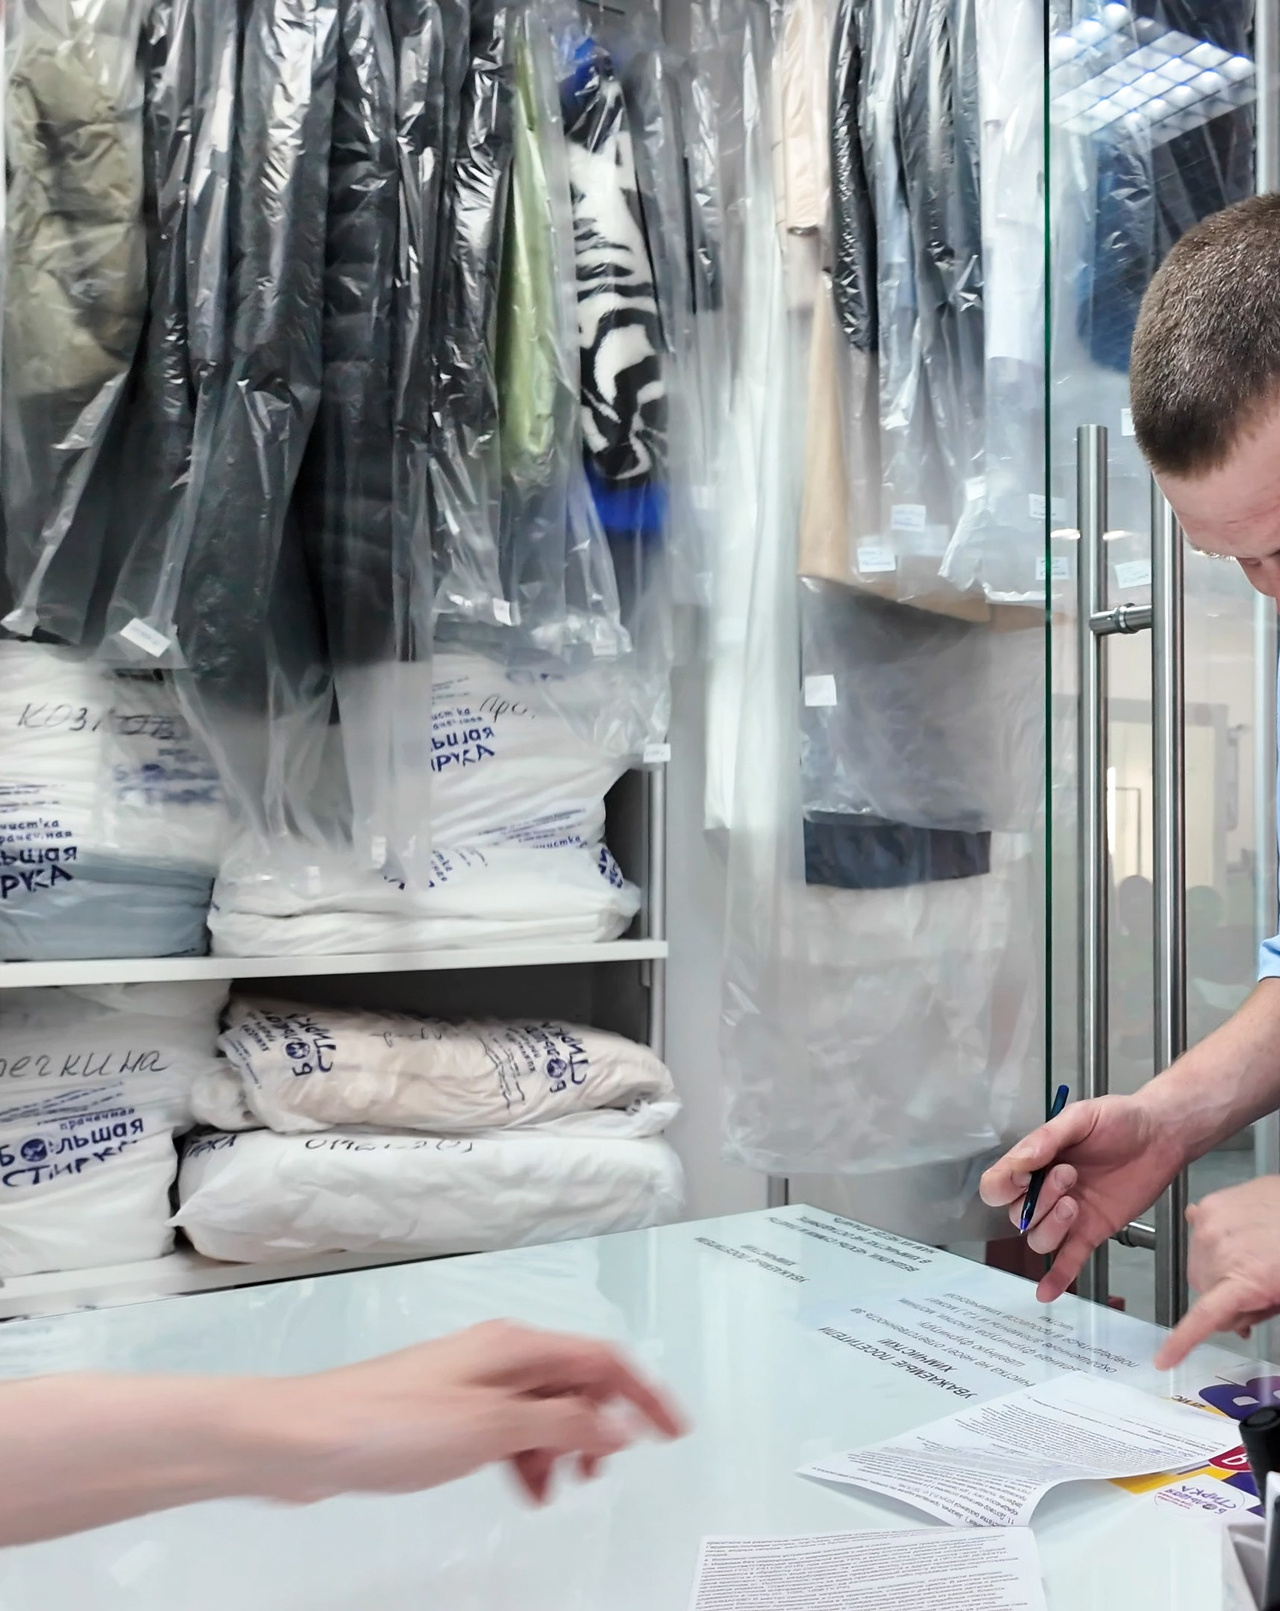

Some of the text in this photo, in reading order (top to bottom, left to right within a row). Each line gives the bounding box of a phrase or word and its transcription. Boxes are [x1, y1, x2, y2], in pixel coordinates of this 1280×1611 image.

[818, 1327, 977, 1399] УВАЖАЕМЫЕ ПОСЕТИТЕЛИ
[877, 1339, 957, 1373] ХИМЧИСТКИ!
[990, 1367, 1036, 1387] чистка
